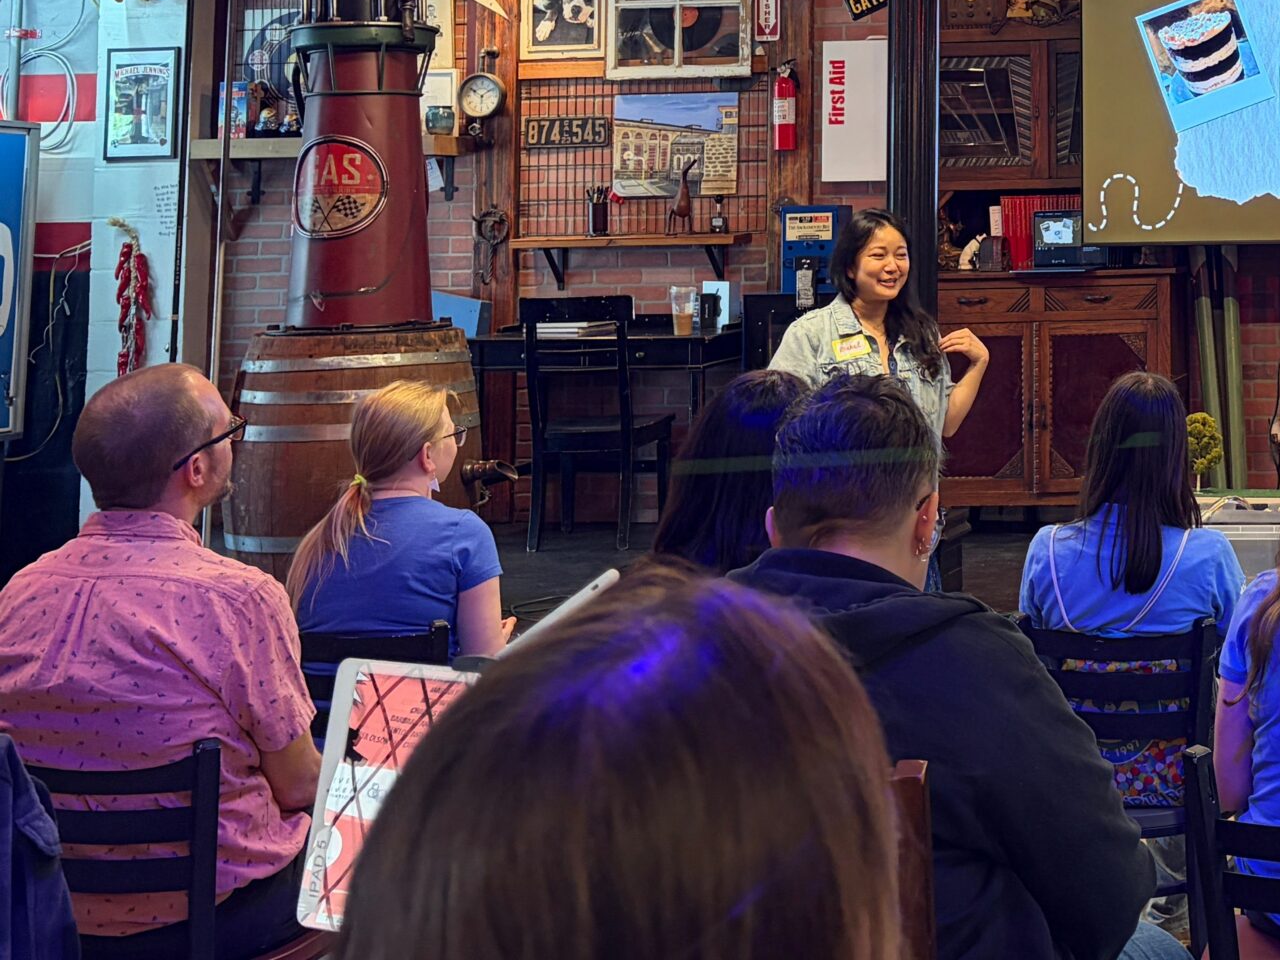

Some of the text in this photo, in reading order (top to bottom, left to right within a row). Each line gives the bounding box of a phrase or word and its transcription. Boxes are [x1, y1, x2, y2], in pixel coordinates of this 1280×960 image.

[114, 66, 170, 80] MICHAEL JENNINGS
[829, 60, 845, 125] First Aid
[528, 119, 605, 144] 874 545
[308, 840, 327, 899] IPAD 5
